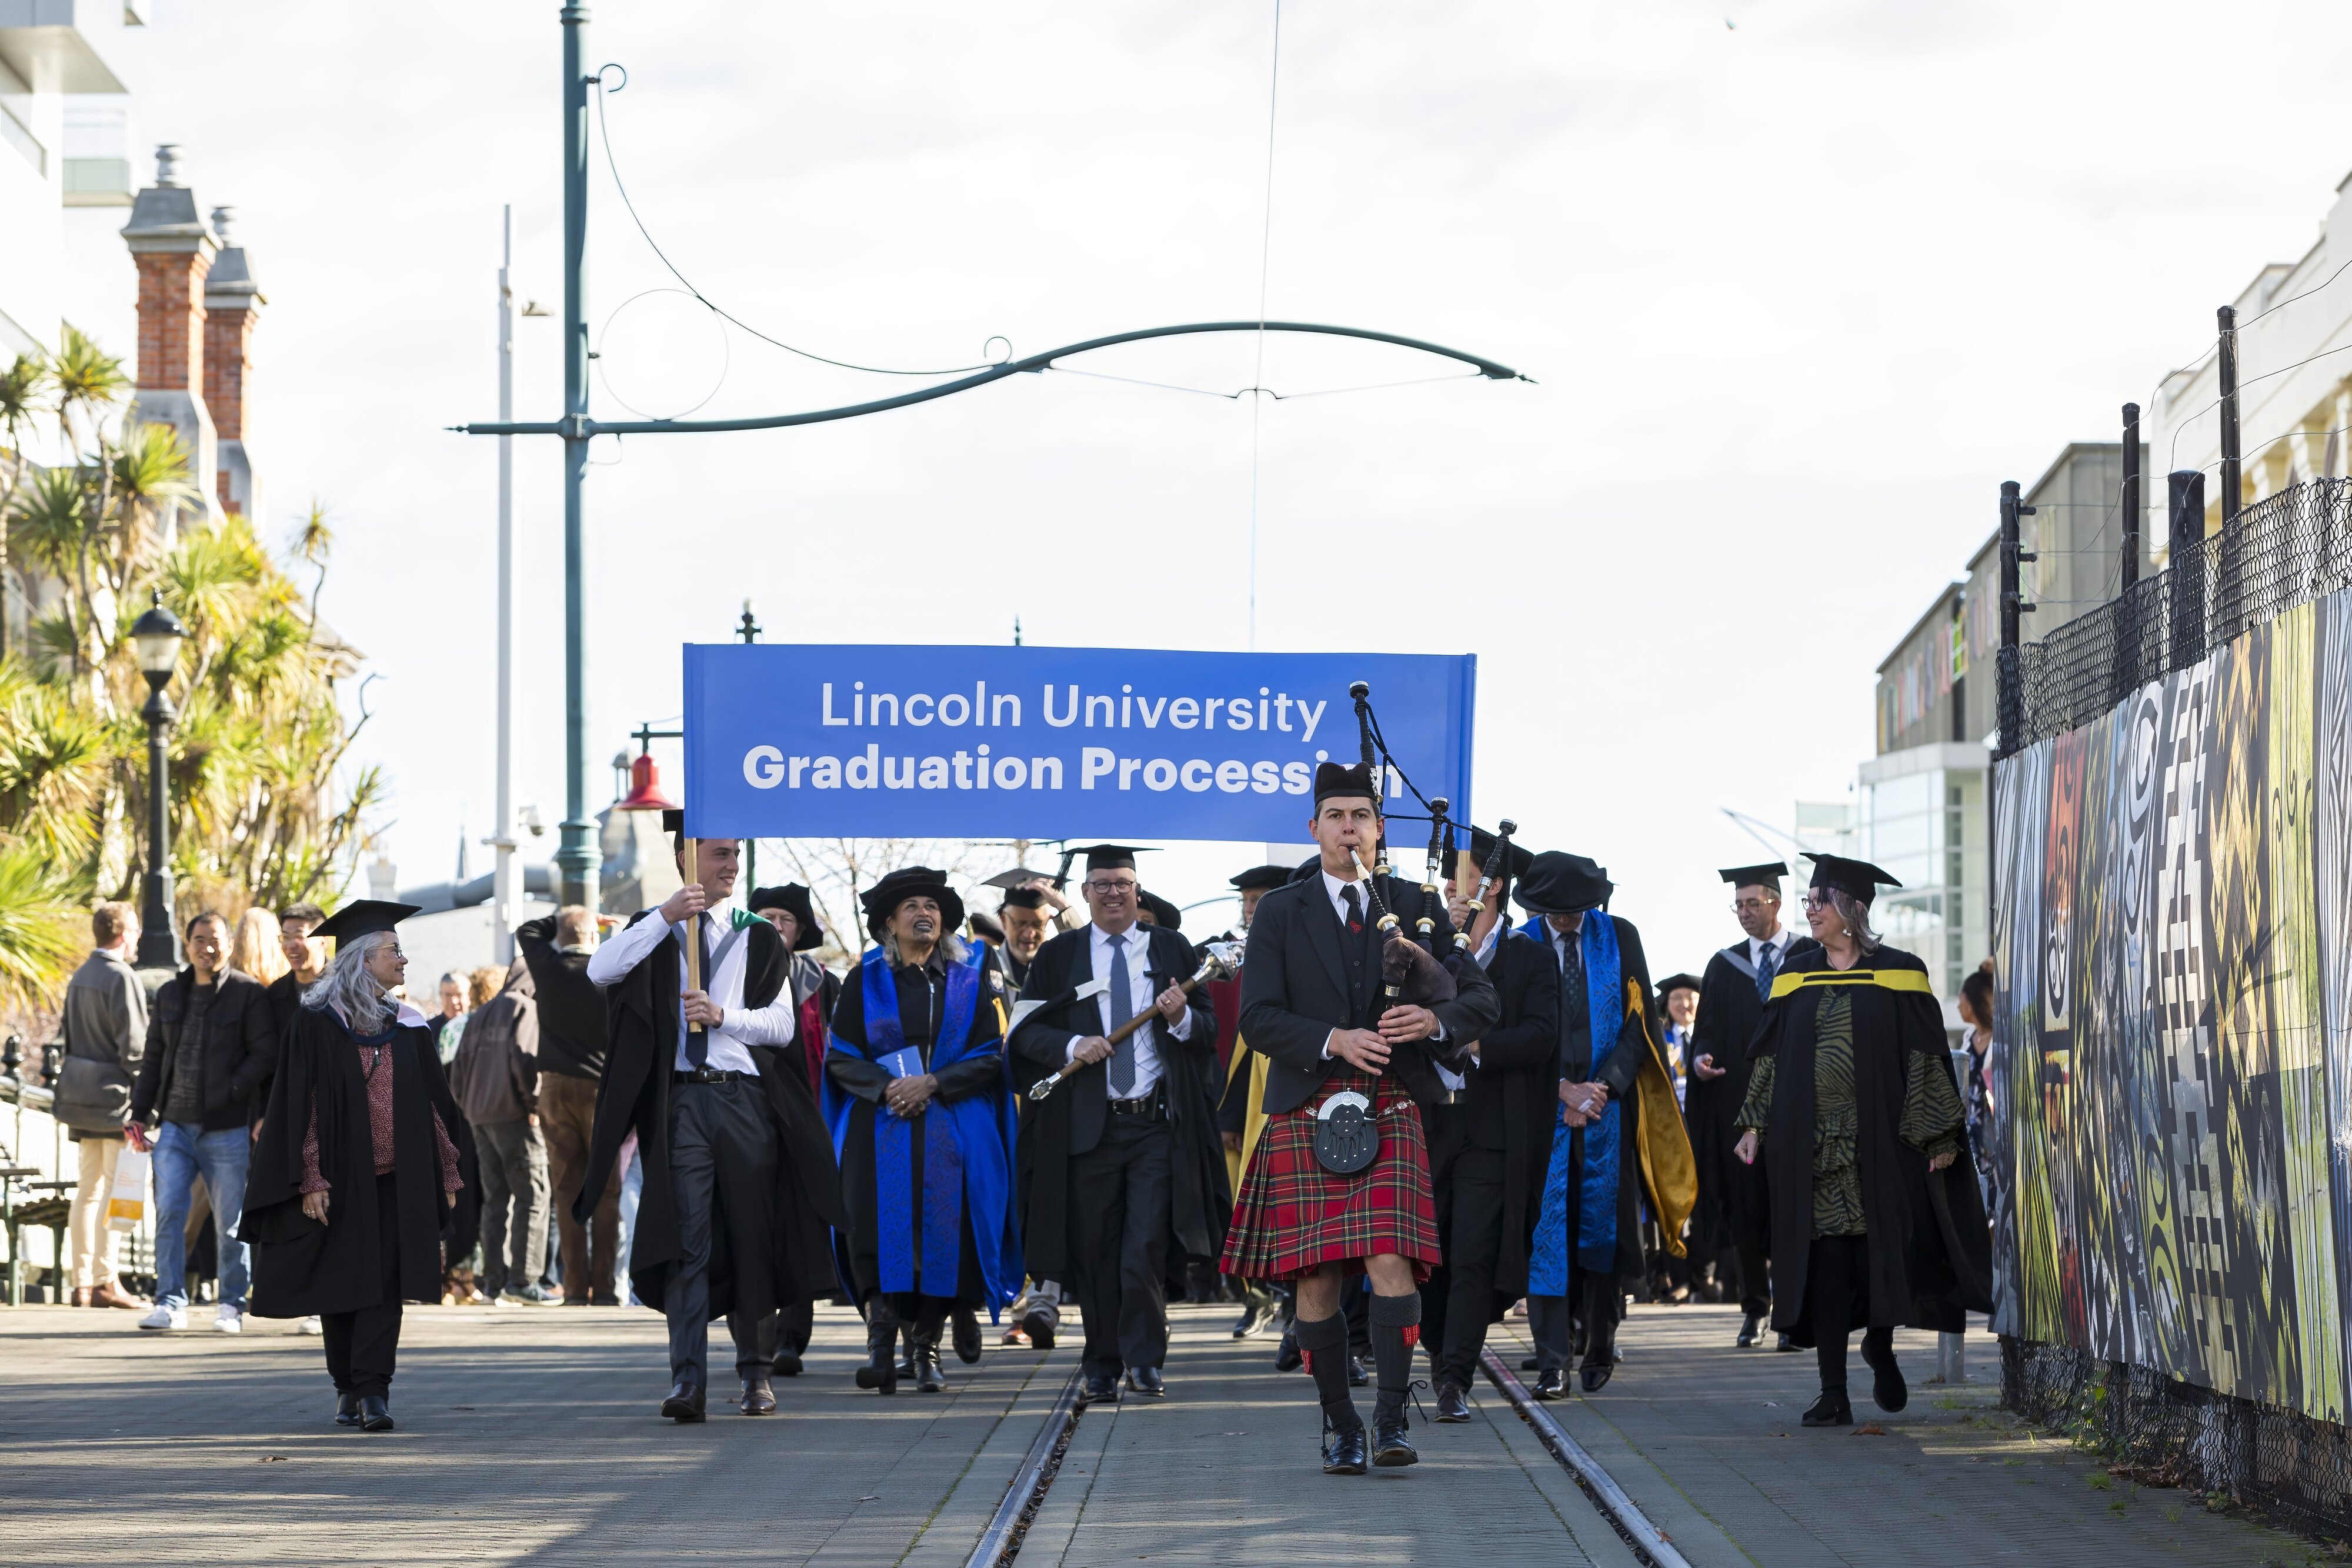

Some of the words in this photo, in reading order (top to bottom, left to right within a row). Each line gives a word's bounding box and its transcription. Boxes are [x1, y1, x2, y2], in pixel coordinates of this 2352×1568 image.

[822, 680, 1021, 726] Lincoln
[1043, 684, 1327, 742] University
[743, 743, 1063, 790] Graduation
[1081, 747, 1403, 798] Processn
